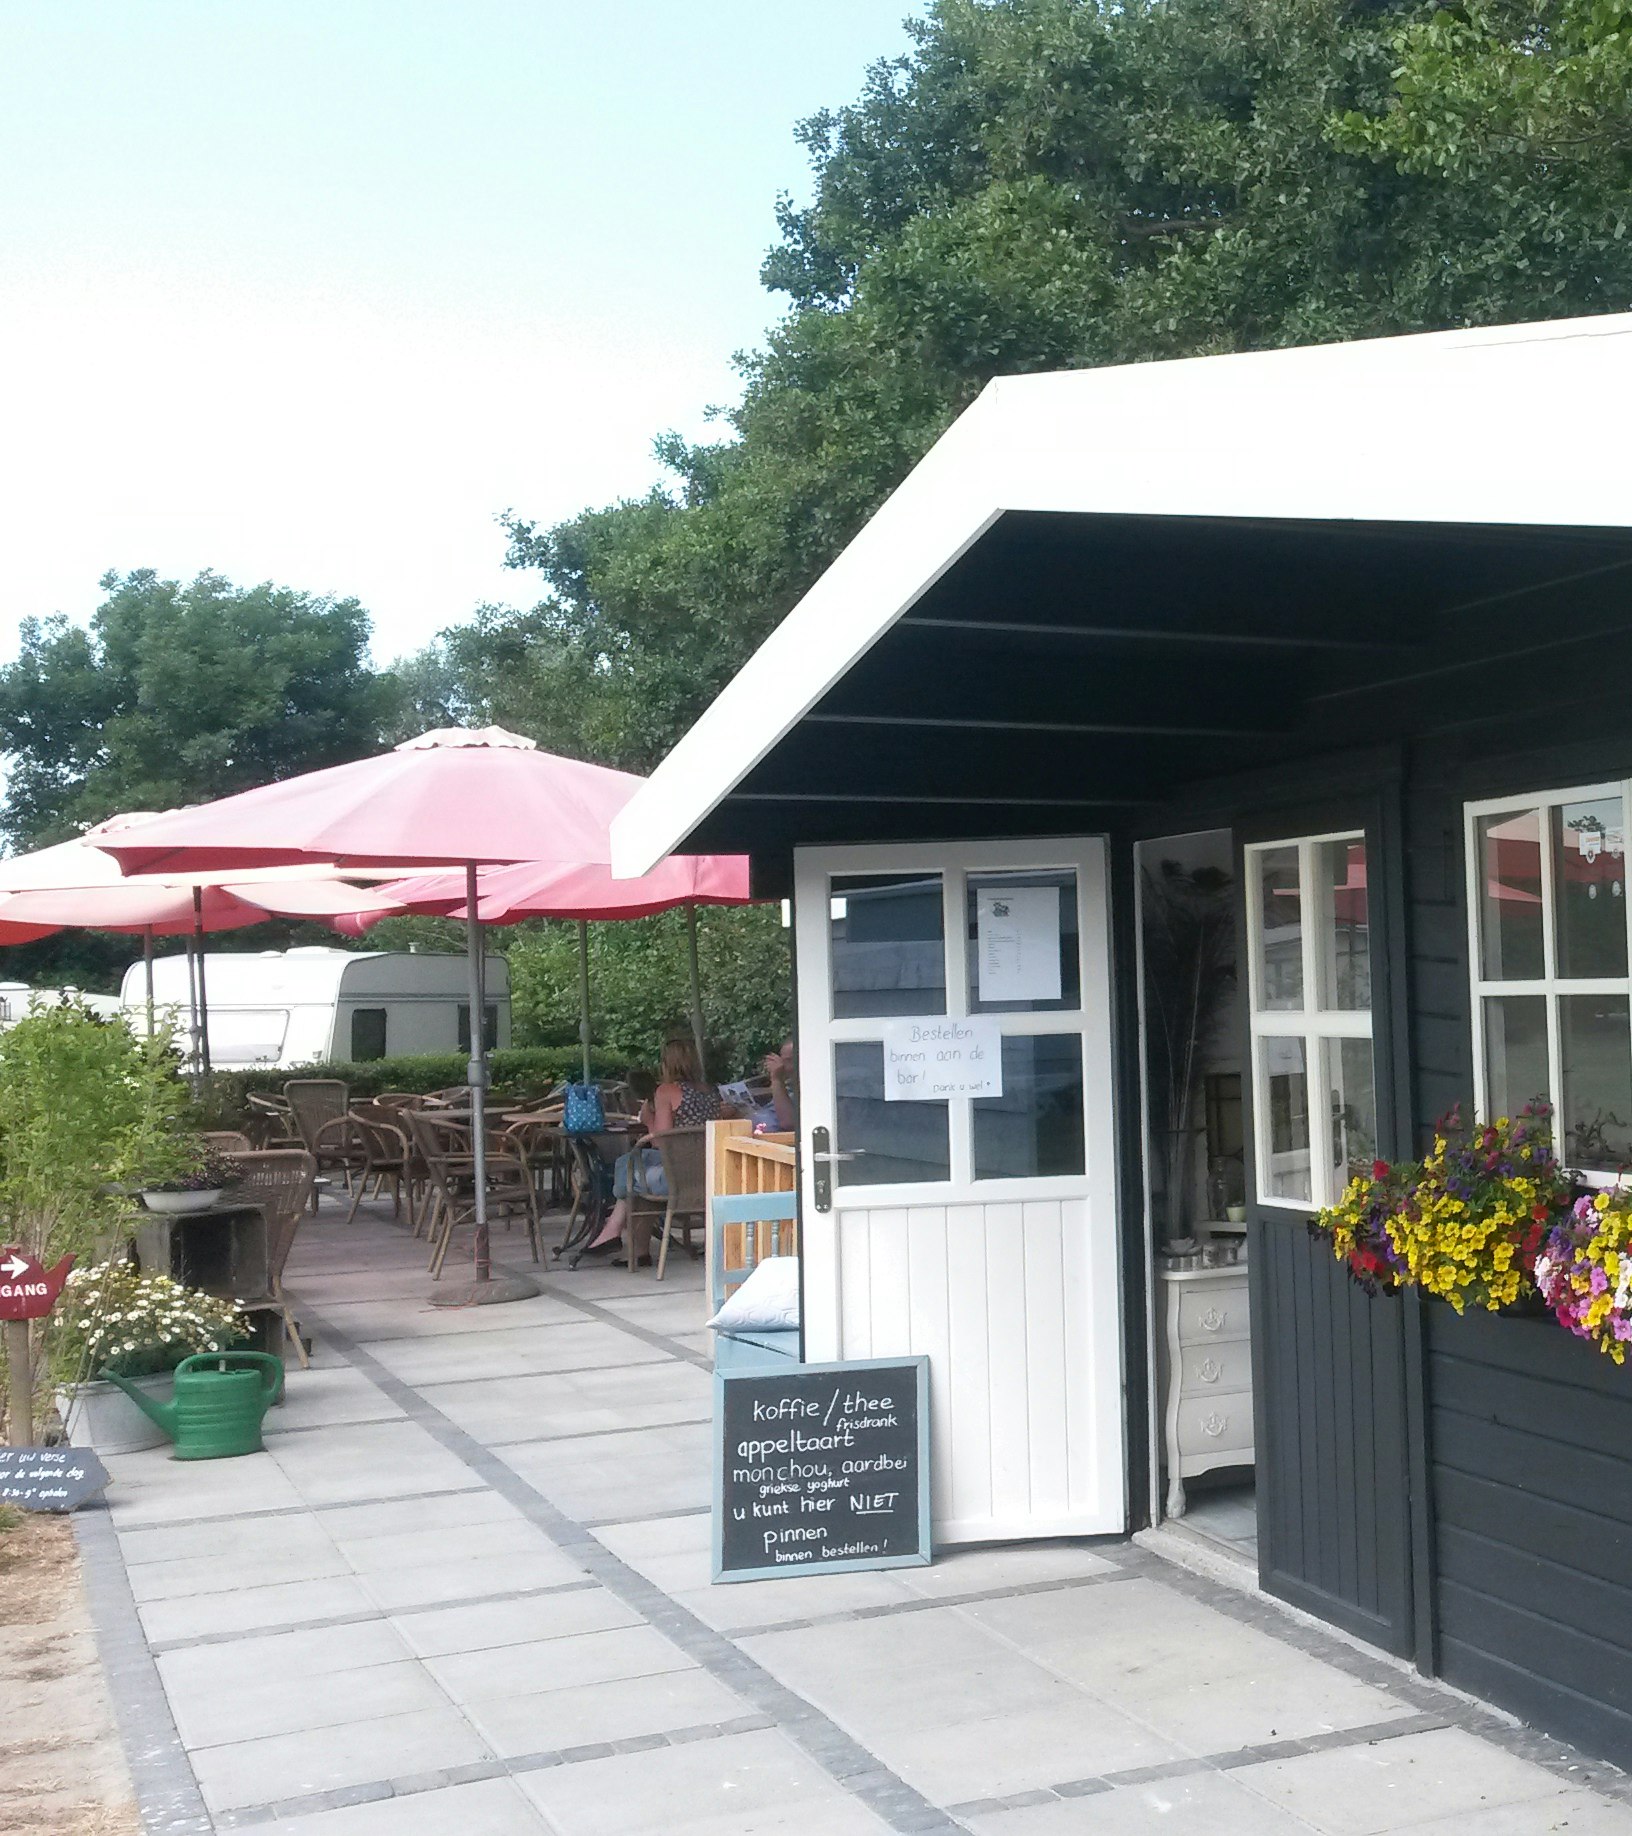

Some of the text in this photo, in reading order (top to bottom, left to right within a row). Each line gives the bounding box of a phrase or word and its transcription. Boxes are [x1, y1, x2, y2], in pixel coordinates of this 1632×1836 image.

[909, 1023, 973, 1042] Bestellen
[890, 1044, 985, 1062] binnen aan de
[0, 1282, 48, 1297] GANG
[836, 1413, 898, 1431] frisdrank
[737, 1429, 855, 1463] appeltaart
[841, 1453, 908, 1474] aardbei
[759, 1477, 850, 1498] griekse yoghurt
[733, 1492, 900, 1520] u kunt hier NIET
[763, 1527, 828, 1553] pinnen
[775, 1550, 813, 1563] binnen
